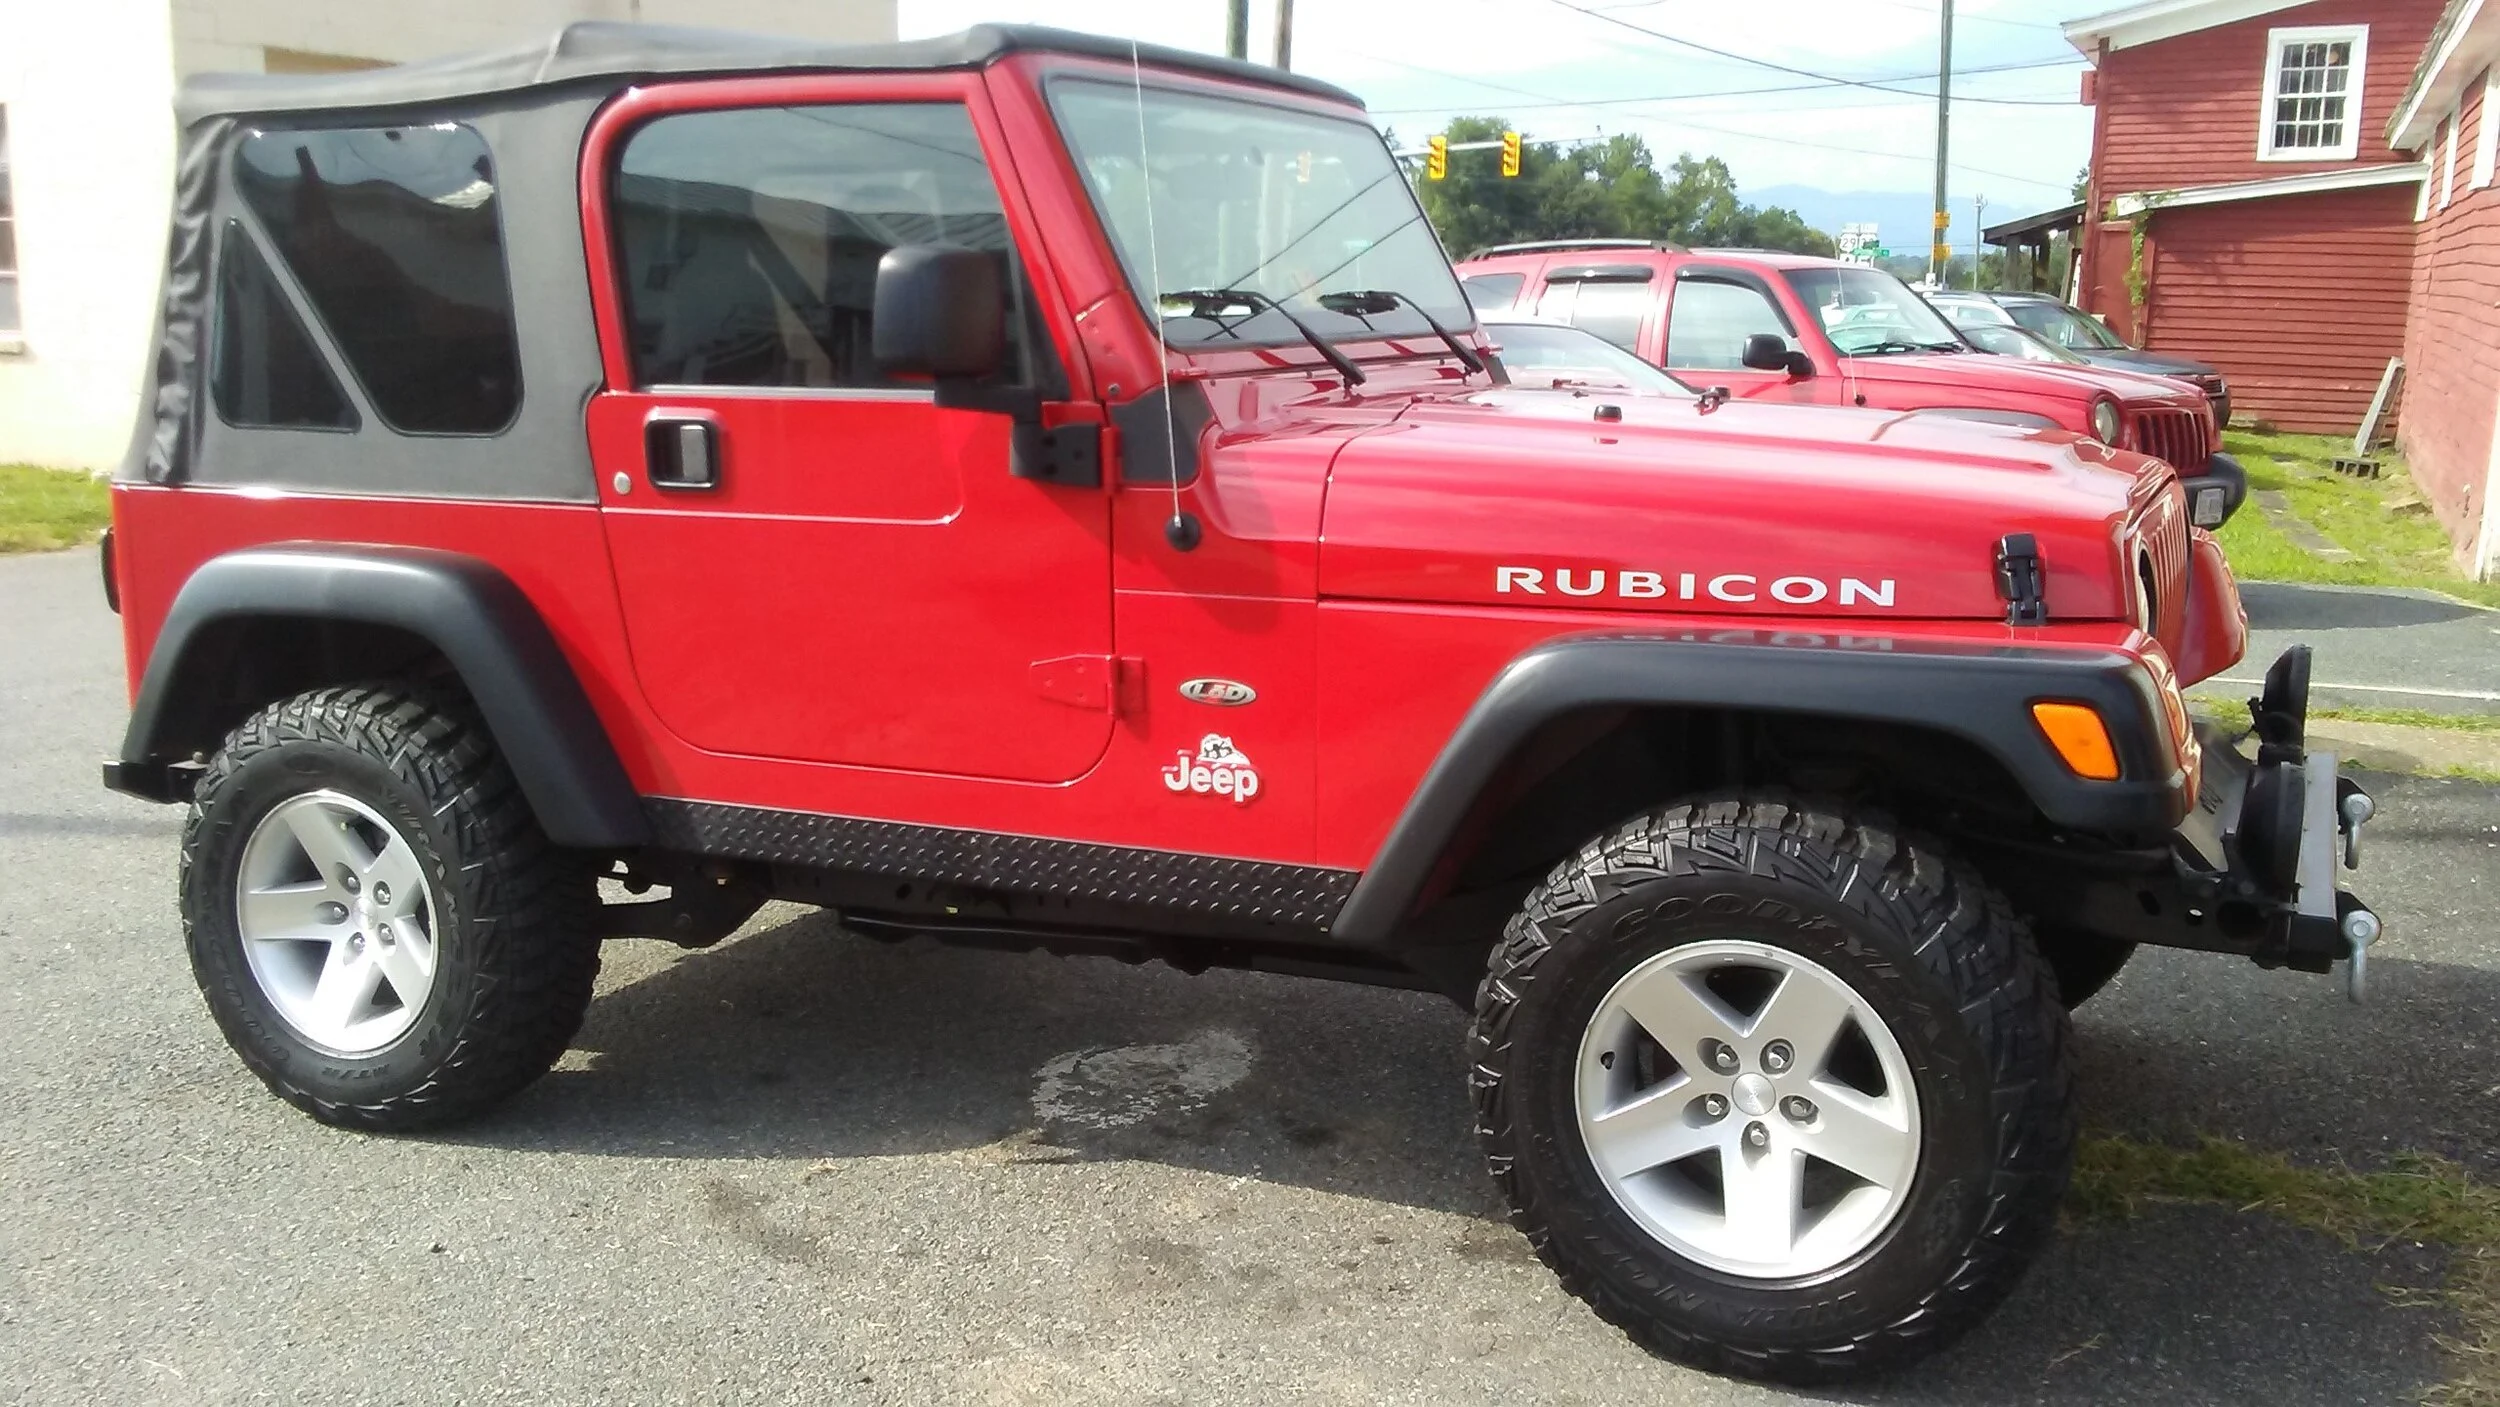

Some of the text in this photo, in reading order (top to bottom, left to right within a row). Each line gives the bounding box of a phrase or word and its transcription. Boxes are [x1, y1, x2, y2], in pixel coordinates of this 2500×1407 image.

[1842, 237, 1856, 249] 29
[1495, 565, 1896, 607] RUBICON
[1163, 755, 1258, 803] Jeep
